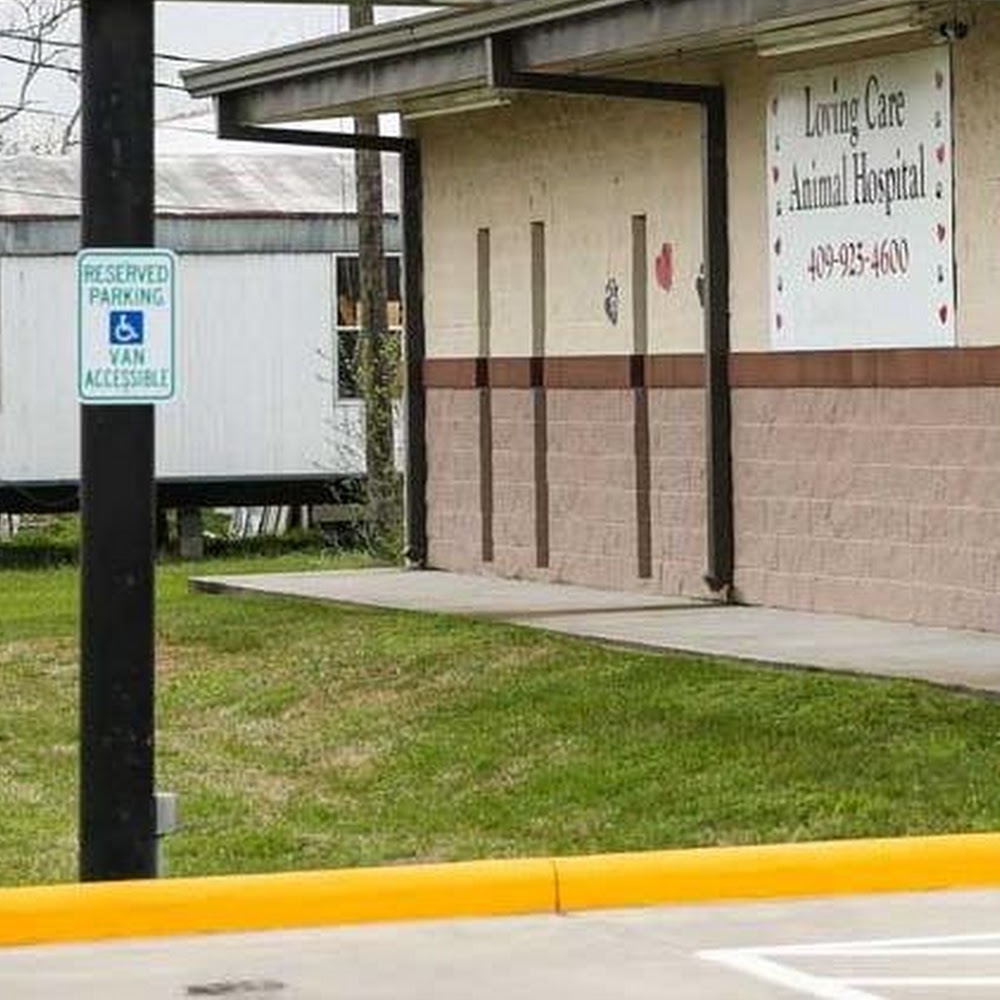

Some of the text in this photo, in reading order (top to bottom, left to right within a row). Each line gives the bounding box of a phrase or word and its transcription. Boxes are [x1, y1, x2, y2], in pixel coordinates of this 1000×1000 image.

[805, 74, 906, 147] Loving Care
[789, 142, 926, 216] Animal Hospital
[807, 238, 910, 282] 409-925-4600
[83, 264, 170, 284] RESERVED
[89, 287, 165, 306] PARKING
[109, 349, 145, 366] VAN
[84, 370, 169, 388] ACCESSIBLE
